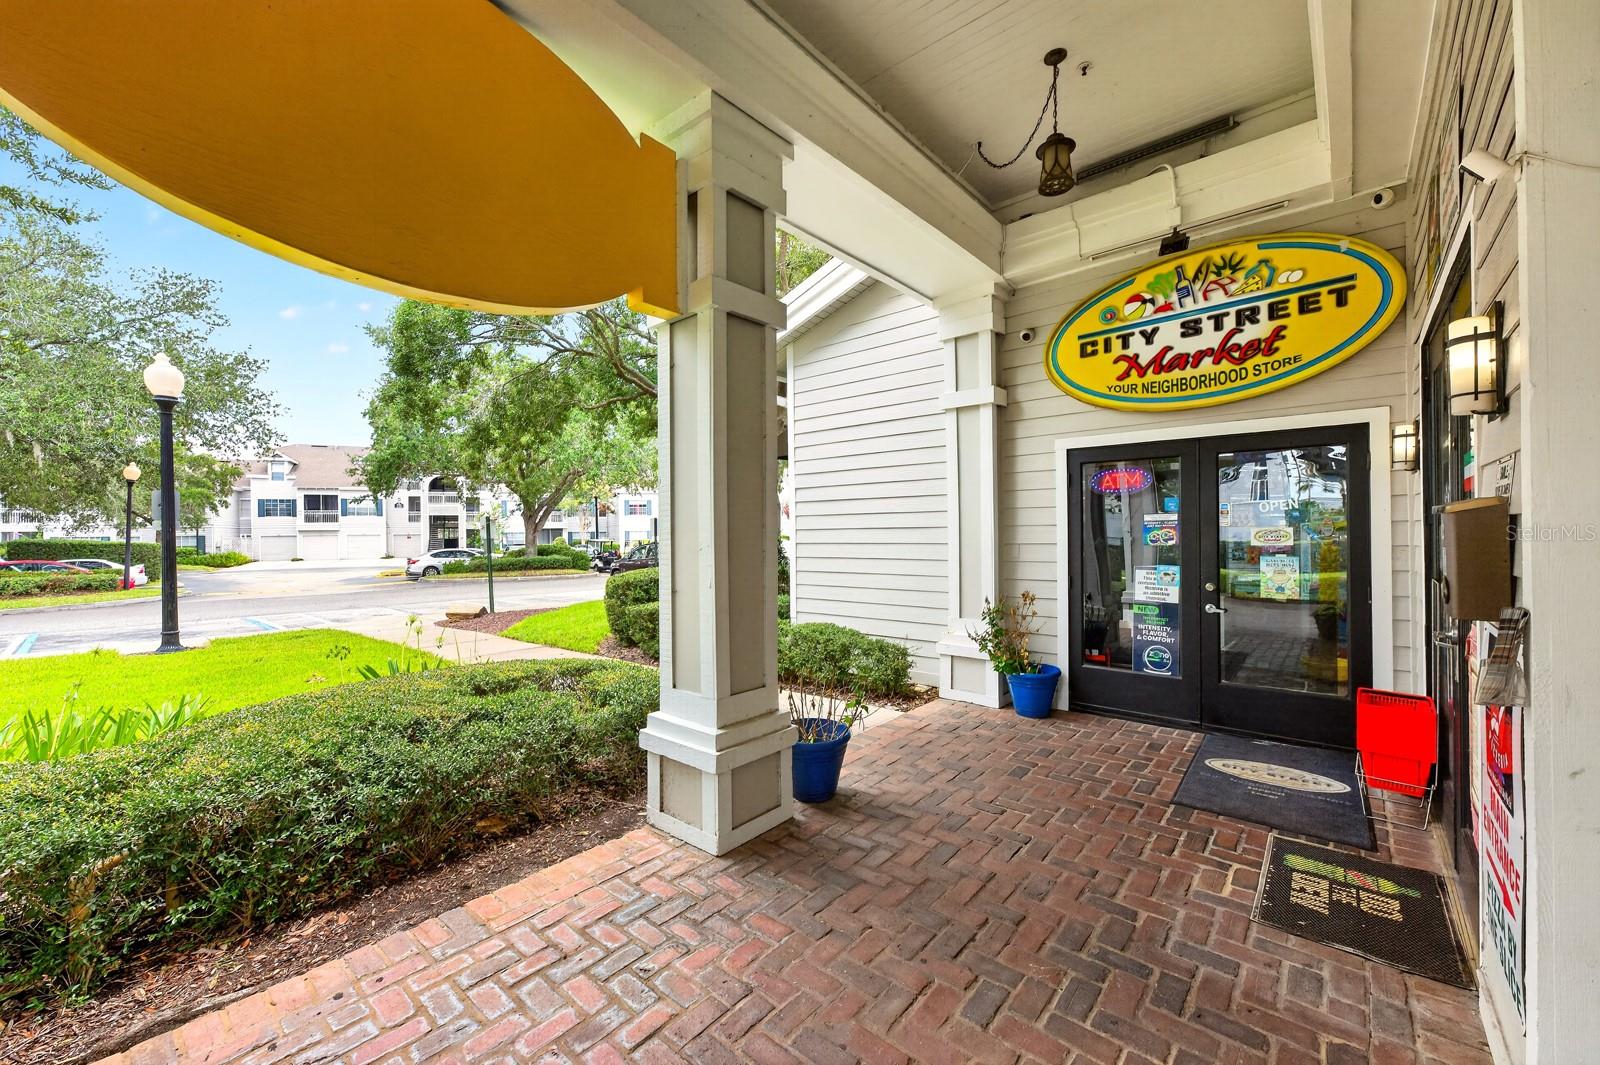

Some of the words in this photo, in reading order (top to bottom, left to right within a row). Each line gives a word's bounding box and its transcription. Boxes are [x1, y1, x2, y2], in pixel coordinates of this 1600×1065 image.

[1079, 326, 1160, 359] CITY
[1180, 284, 1357, 338] STREET
[1112, 325, 1288, 382] Market
[1106, 383, 1139, 394] YOUR
[1141, 366, 1249, 395] NEIGHBORHOOD
[1252, 354, 1303, 377] STORE
[1101, 472, 1142, 489] ATM
[1259, 497, 1299, 513] OPEN
[1138, 623, 1173, 633] INTENSITY,
[1142, 629, 1169, 638] FLAVOR,
[1142, 635, 1175, 644] COMFORT
[1490, 785, 1509, 843] MAIN
[1484, 803, 1521, 906] ENTRANCE
